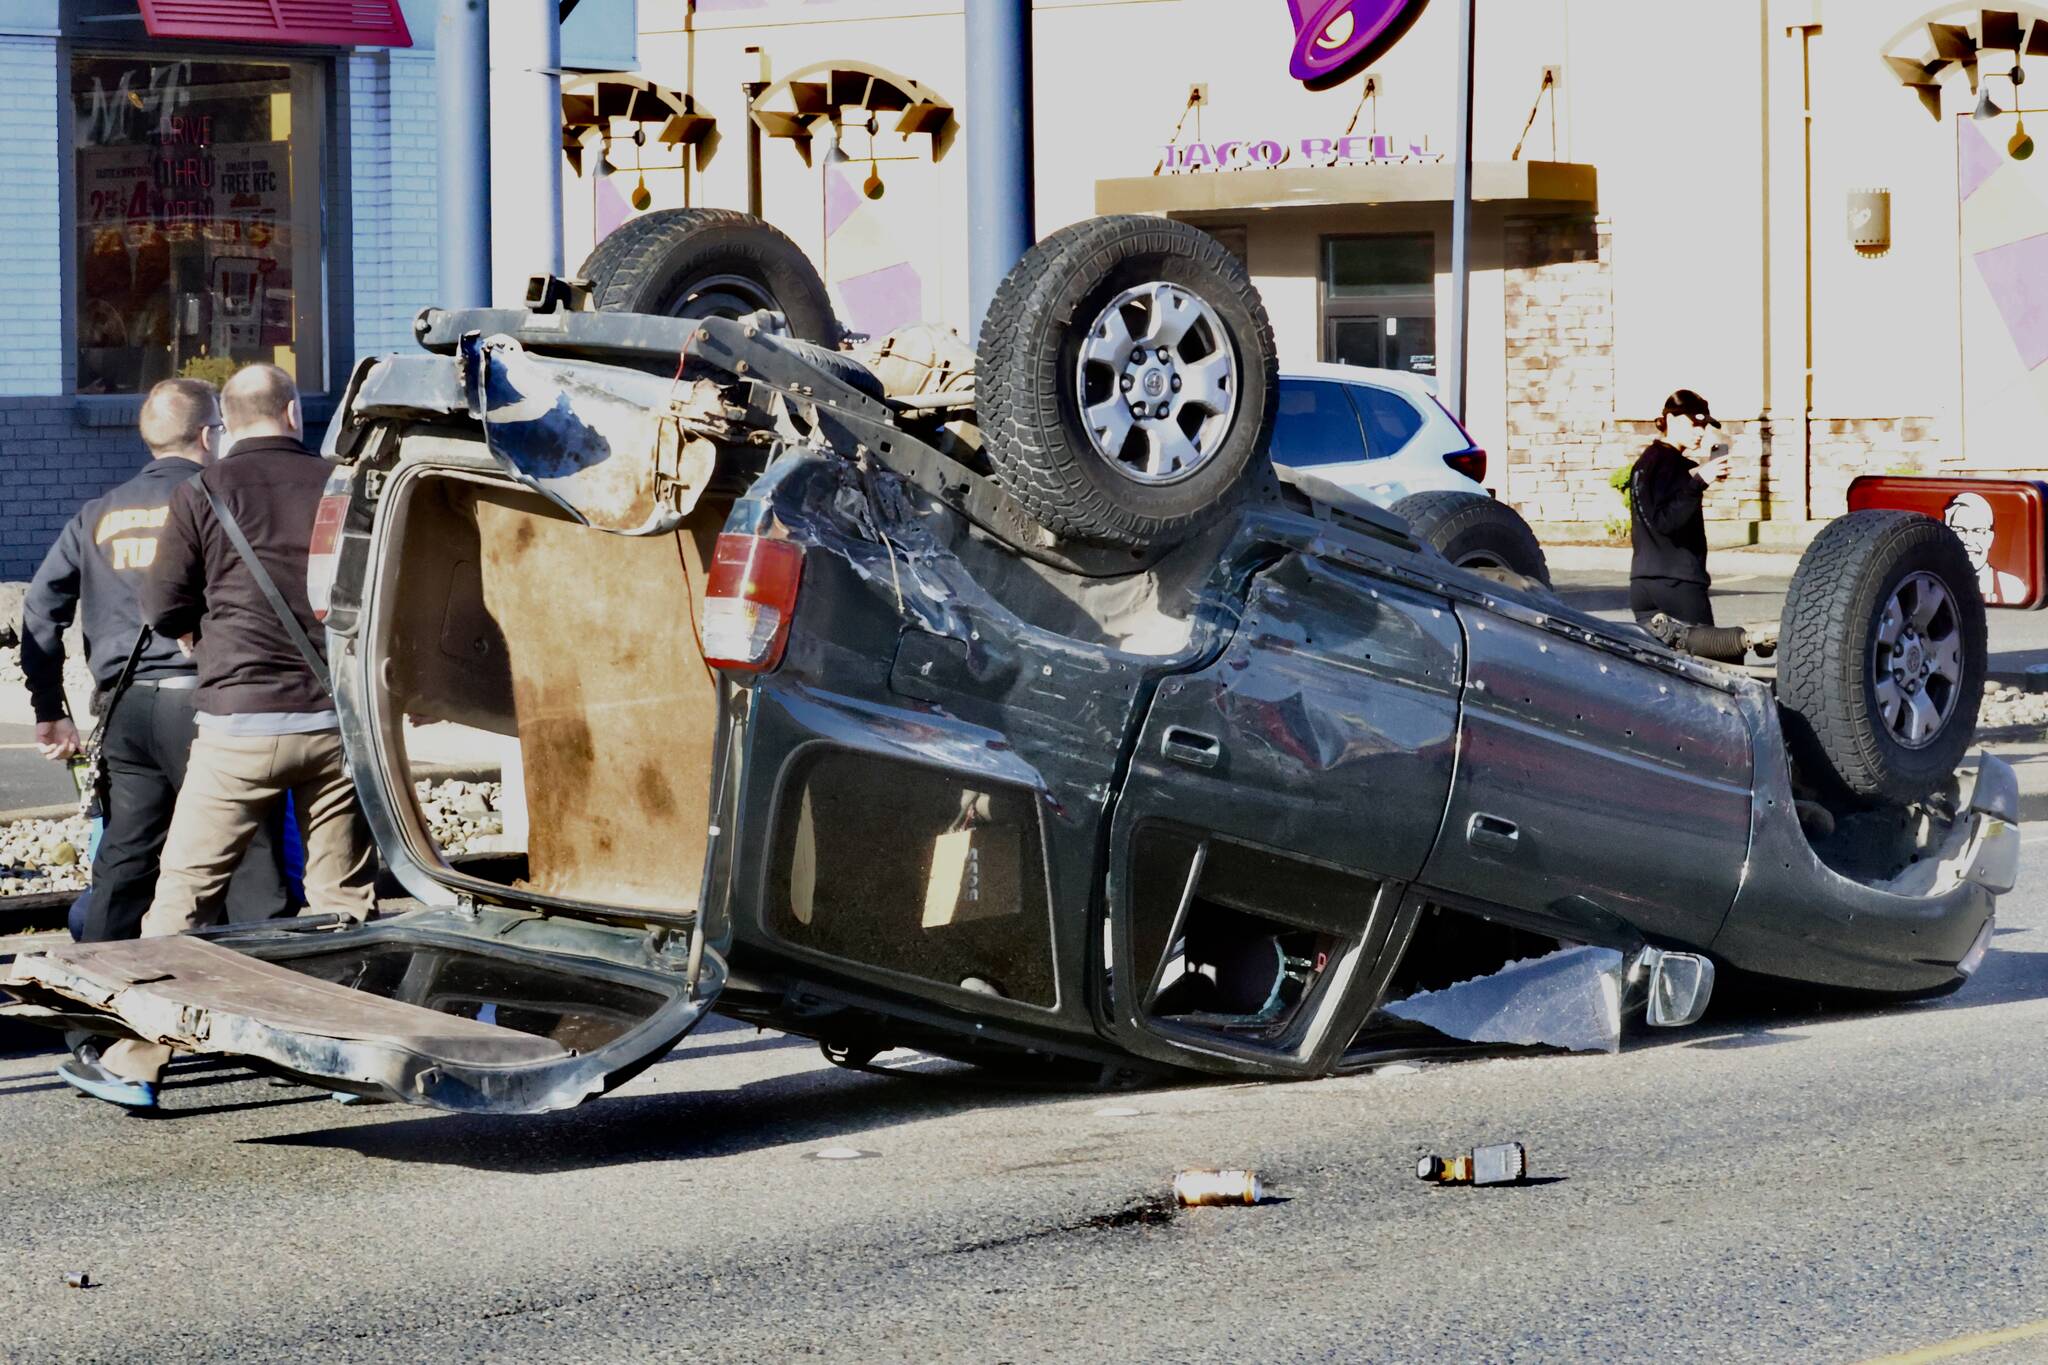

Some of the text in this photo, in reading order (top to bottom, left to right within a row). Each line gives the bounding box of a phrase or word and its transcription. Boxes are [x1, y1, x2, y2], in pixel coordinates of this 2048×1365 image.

[160, 115, 212, 145] DRIVE
[1156, 134, 1443, 167] TACO BELL
[161, 158, 212, 188] THRU
[221, 171, 277, 194] FREE KFC
[162, 200, 212, 230] OPEN
